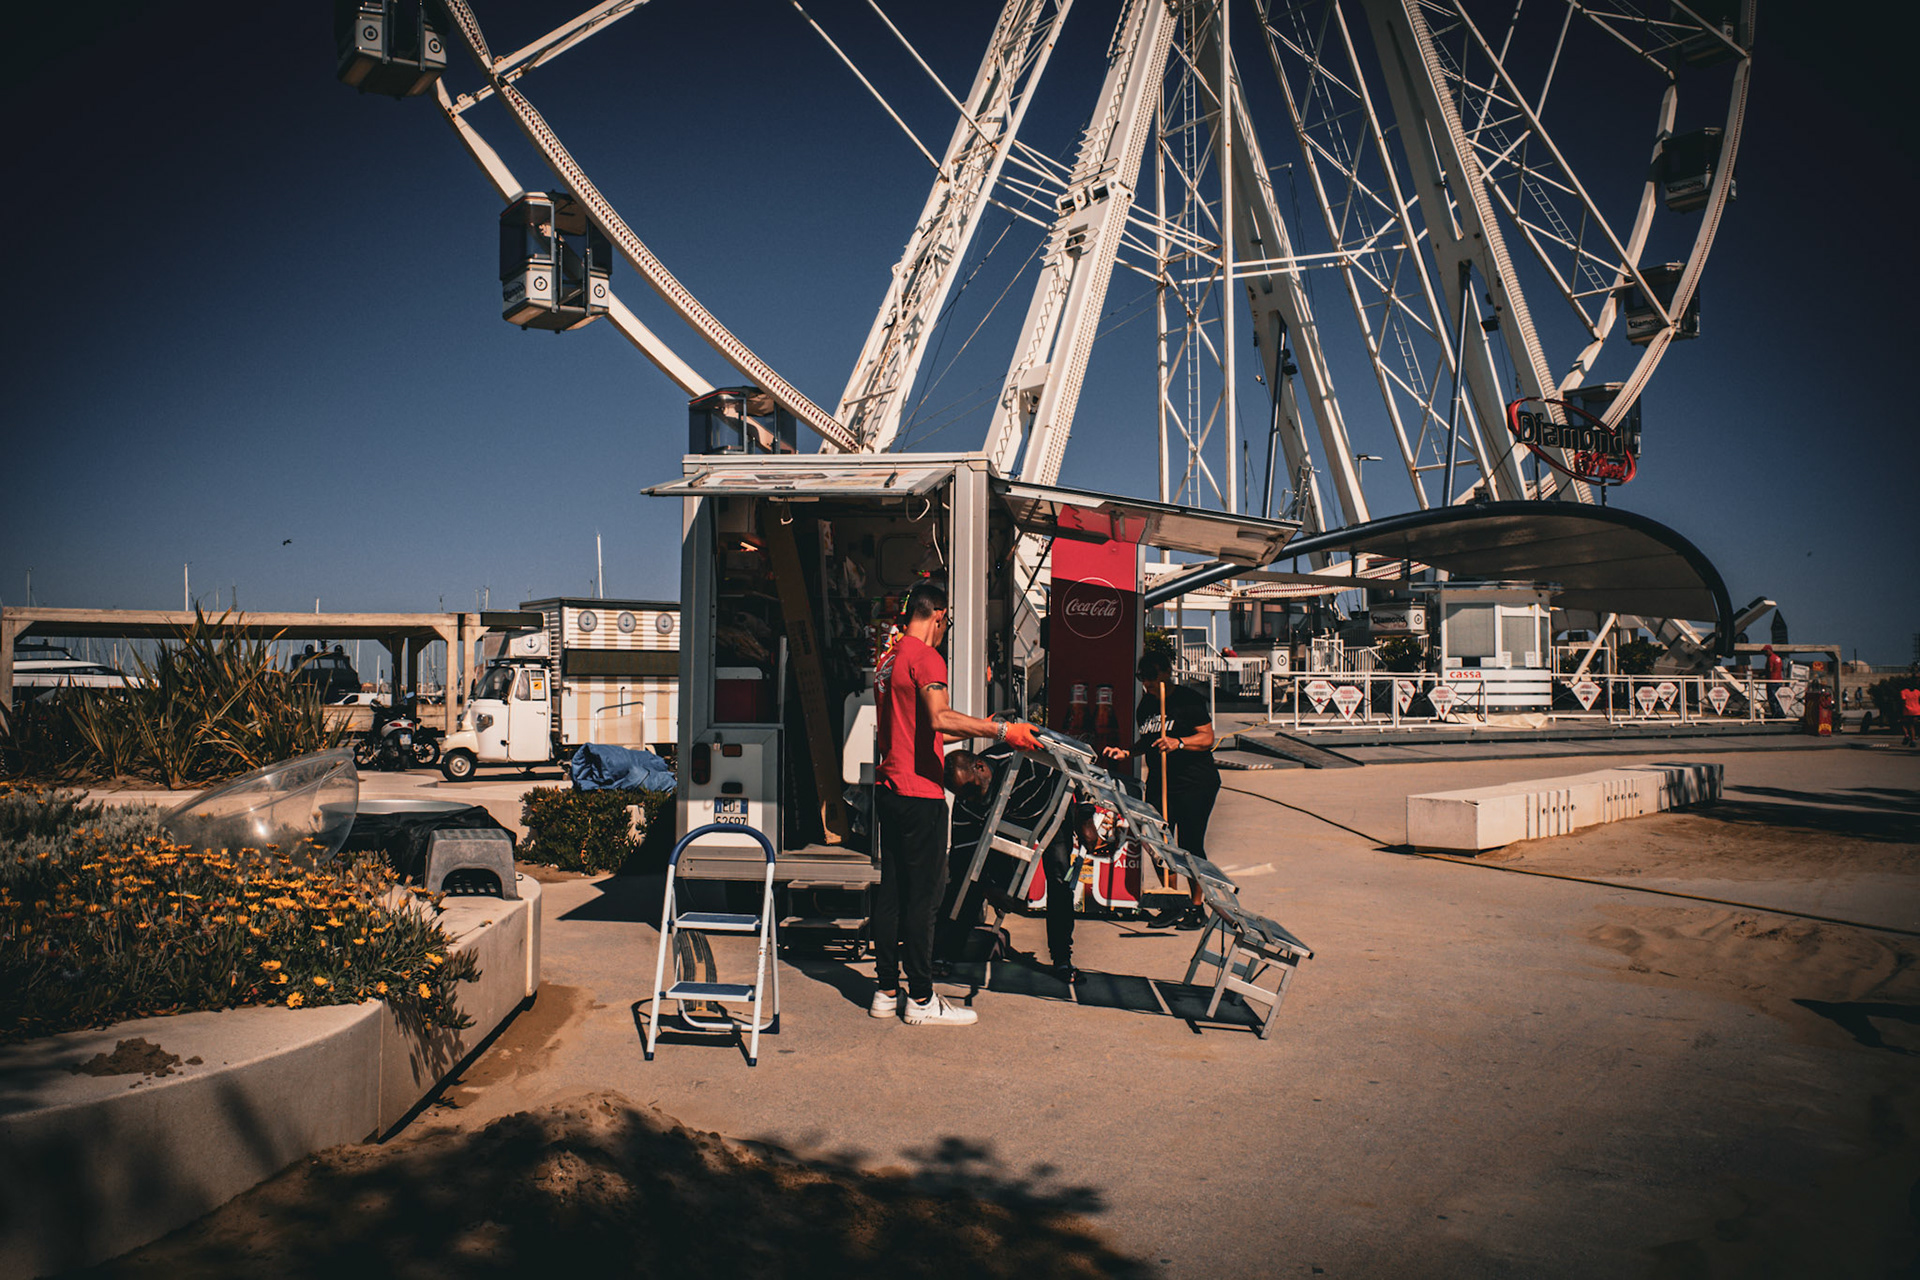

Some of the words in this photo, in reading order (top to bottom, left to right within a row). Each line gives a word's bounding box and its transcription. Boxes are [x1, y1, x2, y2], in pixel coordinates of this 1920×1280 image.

[1519, 411, 1626, 457] Diamond
[1065, 598, 1119, 617] Coca-Cola
[1449, 670, 1482, 679] cassa
